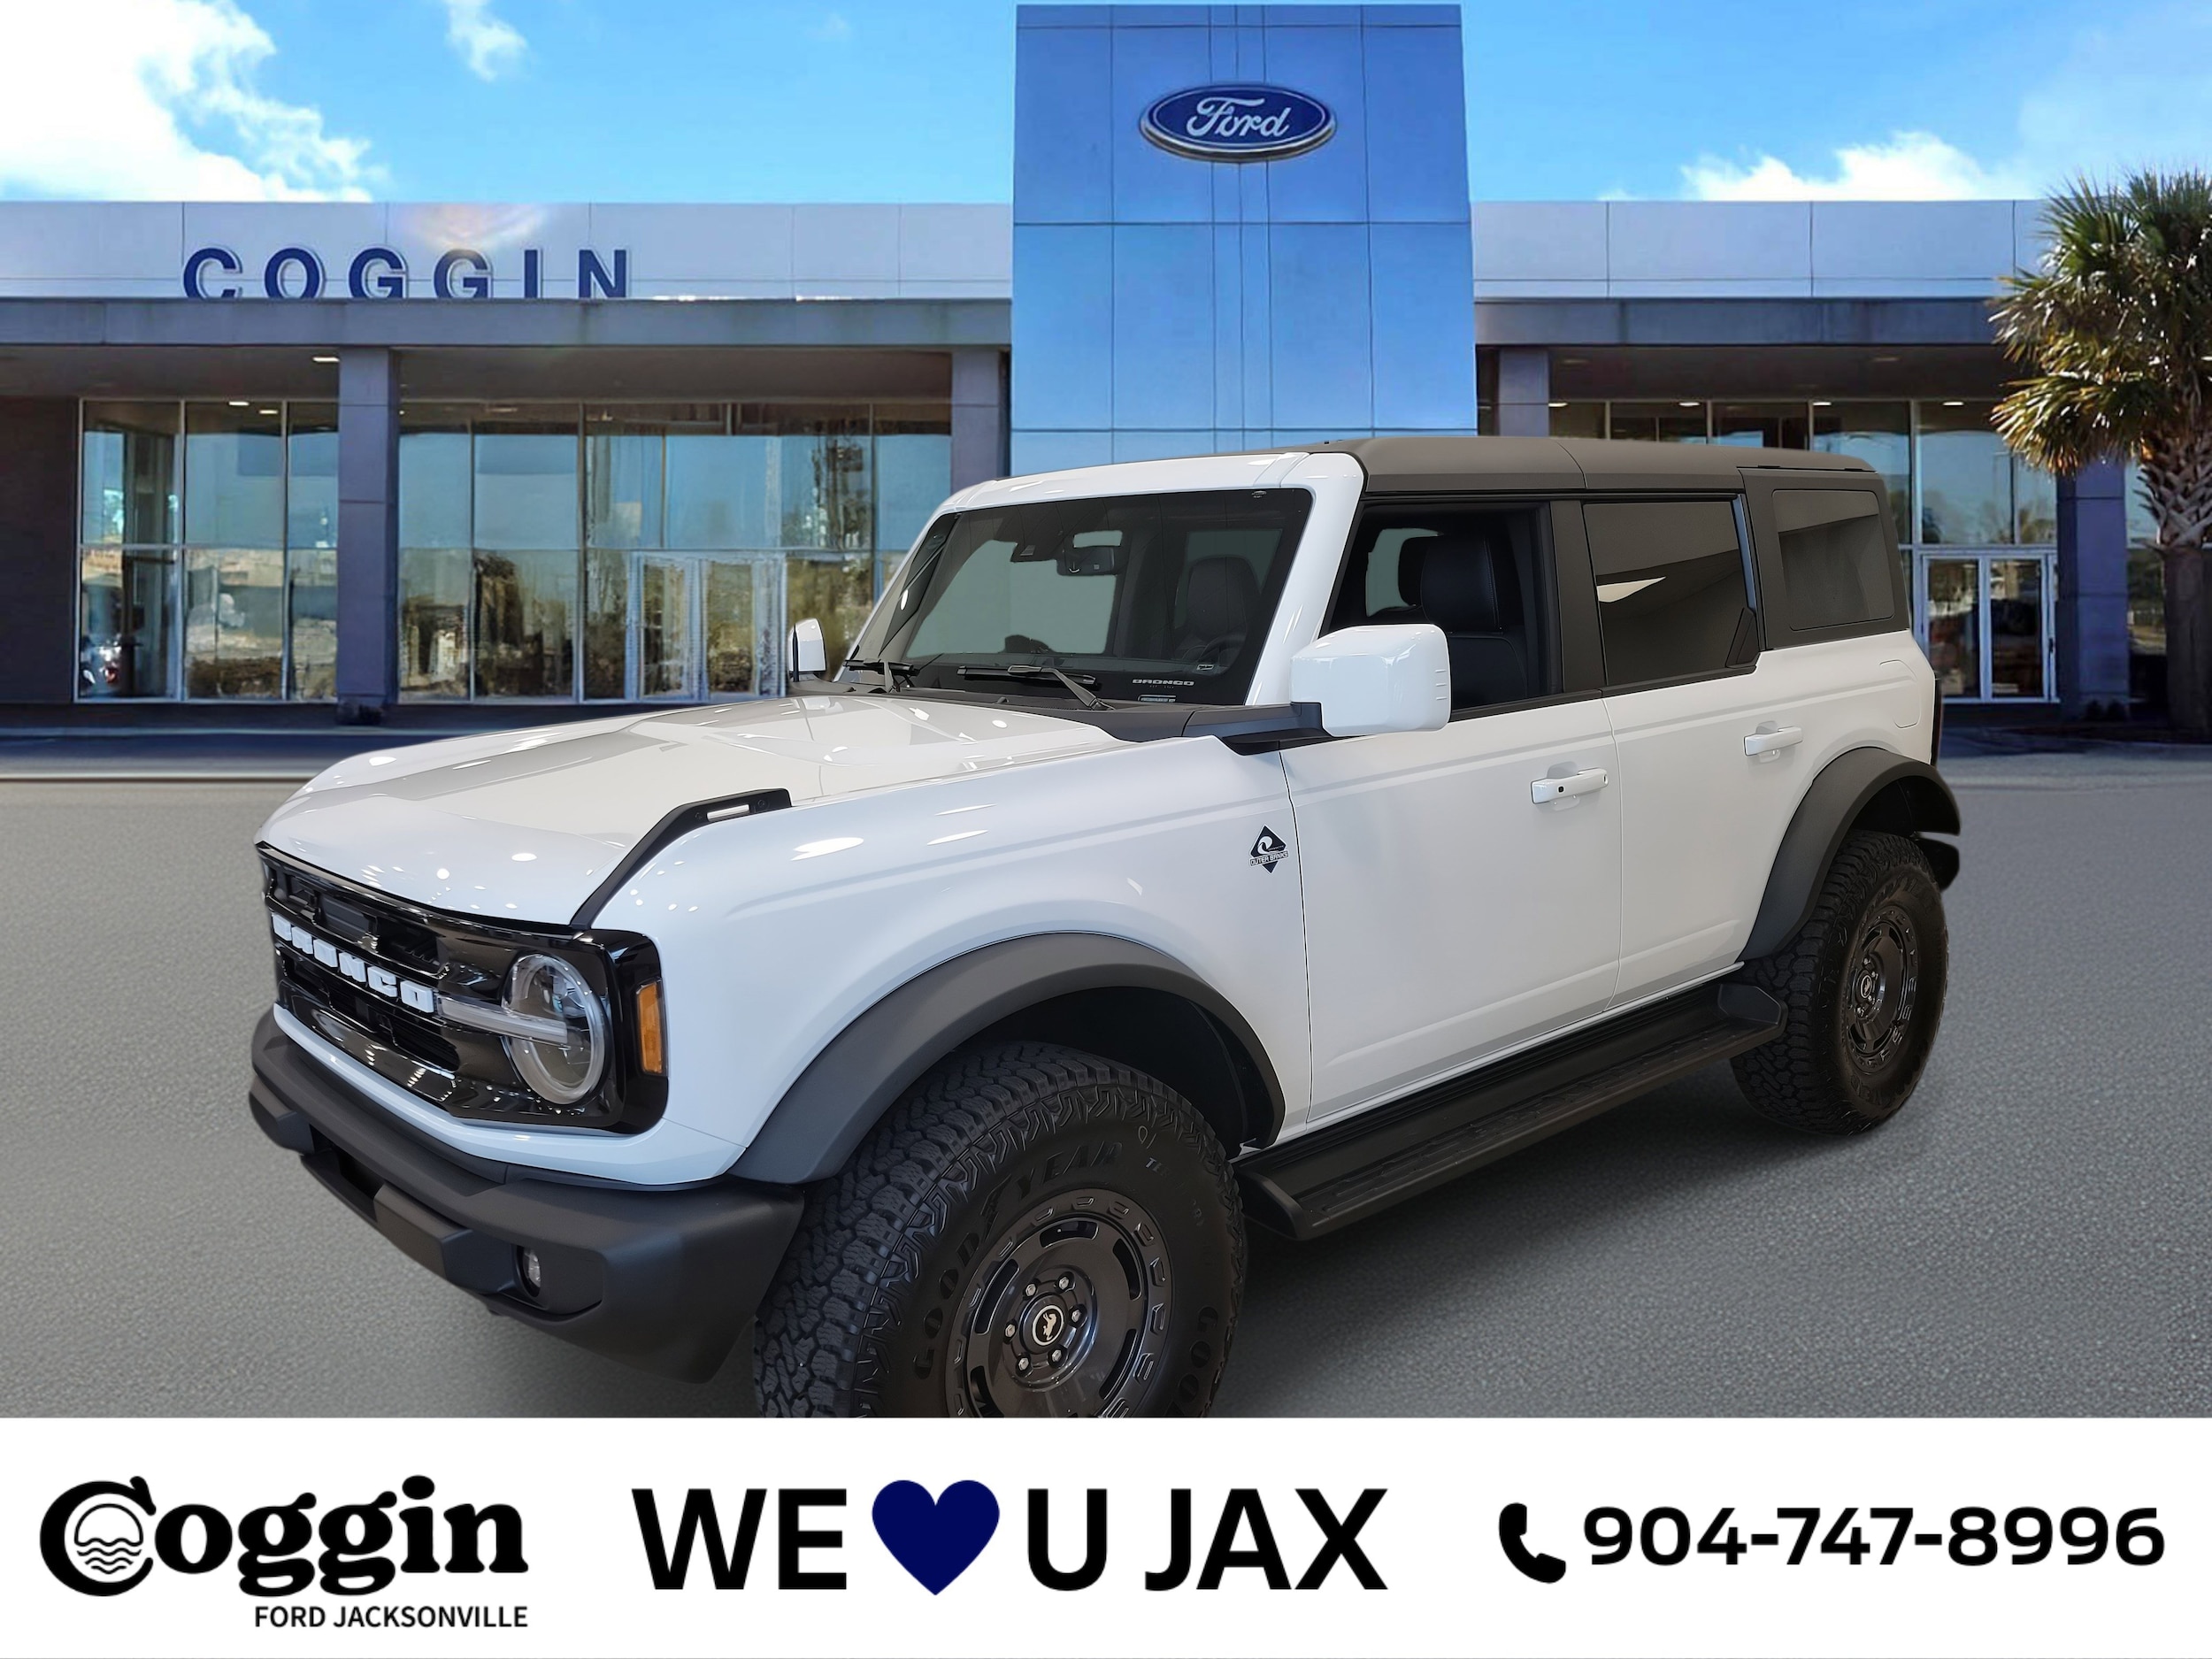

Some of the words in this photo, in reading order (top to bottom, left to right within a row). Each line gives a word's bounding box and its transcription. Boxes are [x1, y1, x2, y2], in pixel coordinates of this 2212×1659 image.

[1187, 96, 1292, 137] Ford
[182, 246, 629, 299] COGGIN
[1250, 856, 1270, 865] OUTER
[1270, 851, 1288, 862] BANKS
[273, 913, 434, 1014] BRONCO
